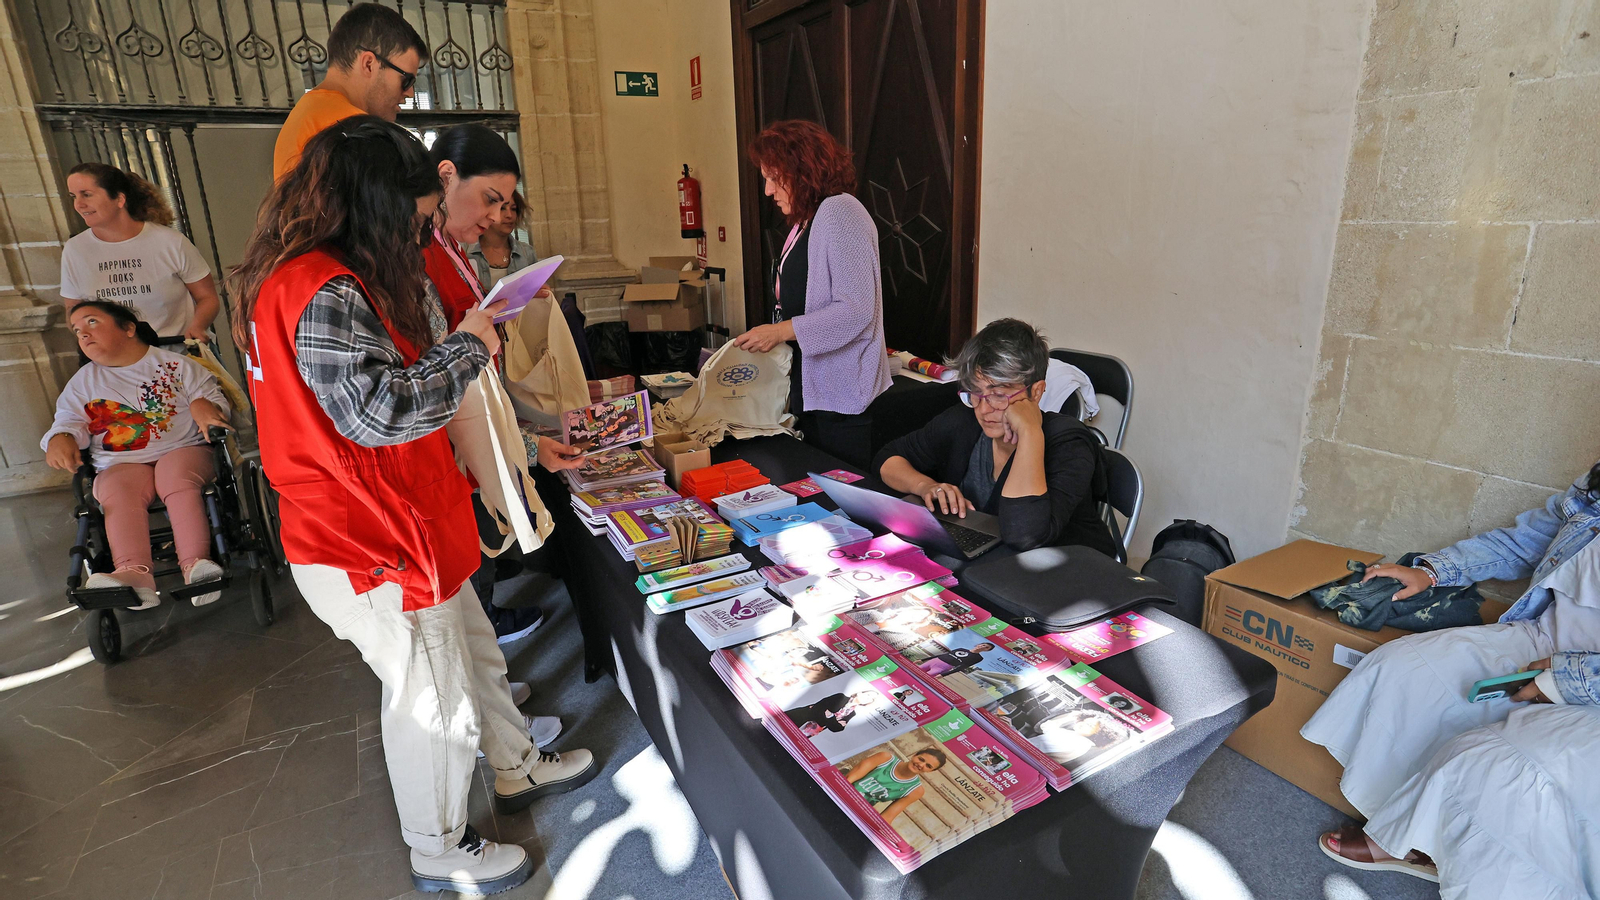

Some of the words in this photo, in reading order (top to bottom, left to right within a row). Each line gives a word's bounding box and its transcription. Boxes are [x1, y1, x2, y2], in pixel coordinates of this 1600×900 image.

[98, 259, 142, 271] HAPPINESS
[108, 272, 134, 284] LOOKS
[96, 286, 138, 298] GORGEOUS
[140, 284, 152, 294] ON
[1243, 610, 1294, 648] CN
[1222, 626, 1252, 644] CLUB
[1254, 640, 1310, 670] NAUTICO
[892, 699, 916, 718] conseguido
[917, 703, 930, 713] ella
[875, 707, 900, 726] LÁNZATE
[973, 766, 1004, 791] conseguido
[1001, 780, 1011, 788] ha
[1002, 771, 1019, 784] ella
[954, 776, 986, 802] LÁNZATE
[983, 786, 996, 796] tú?
